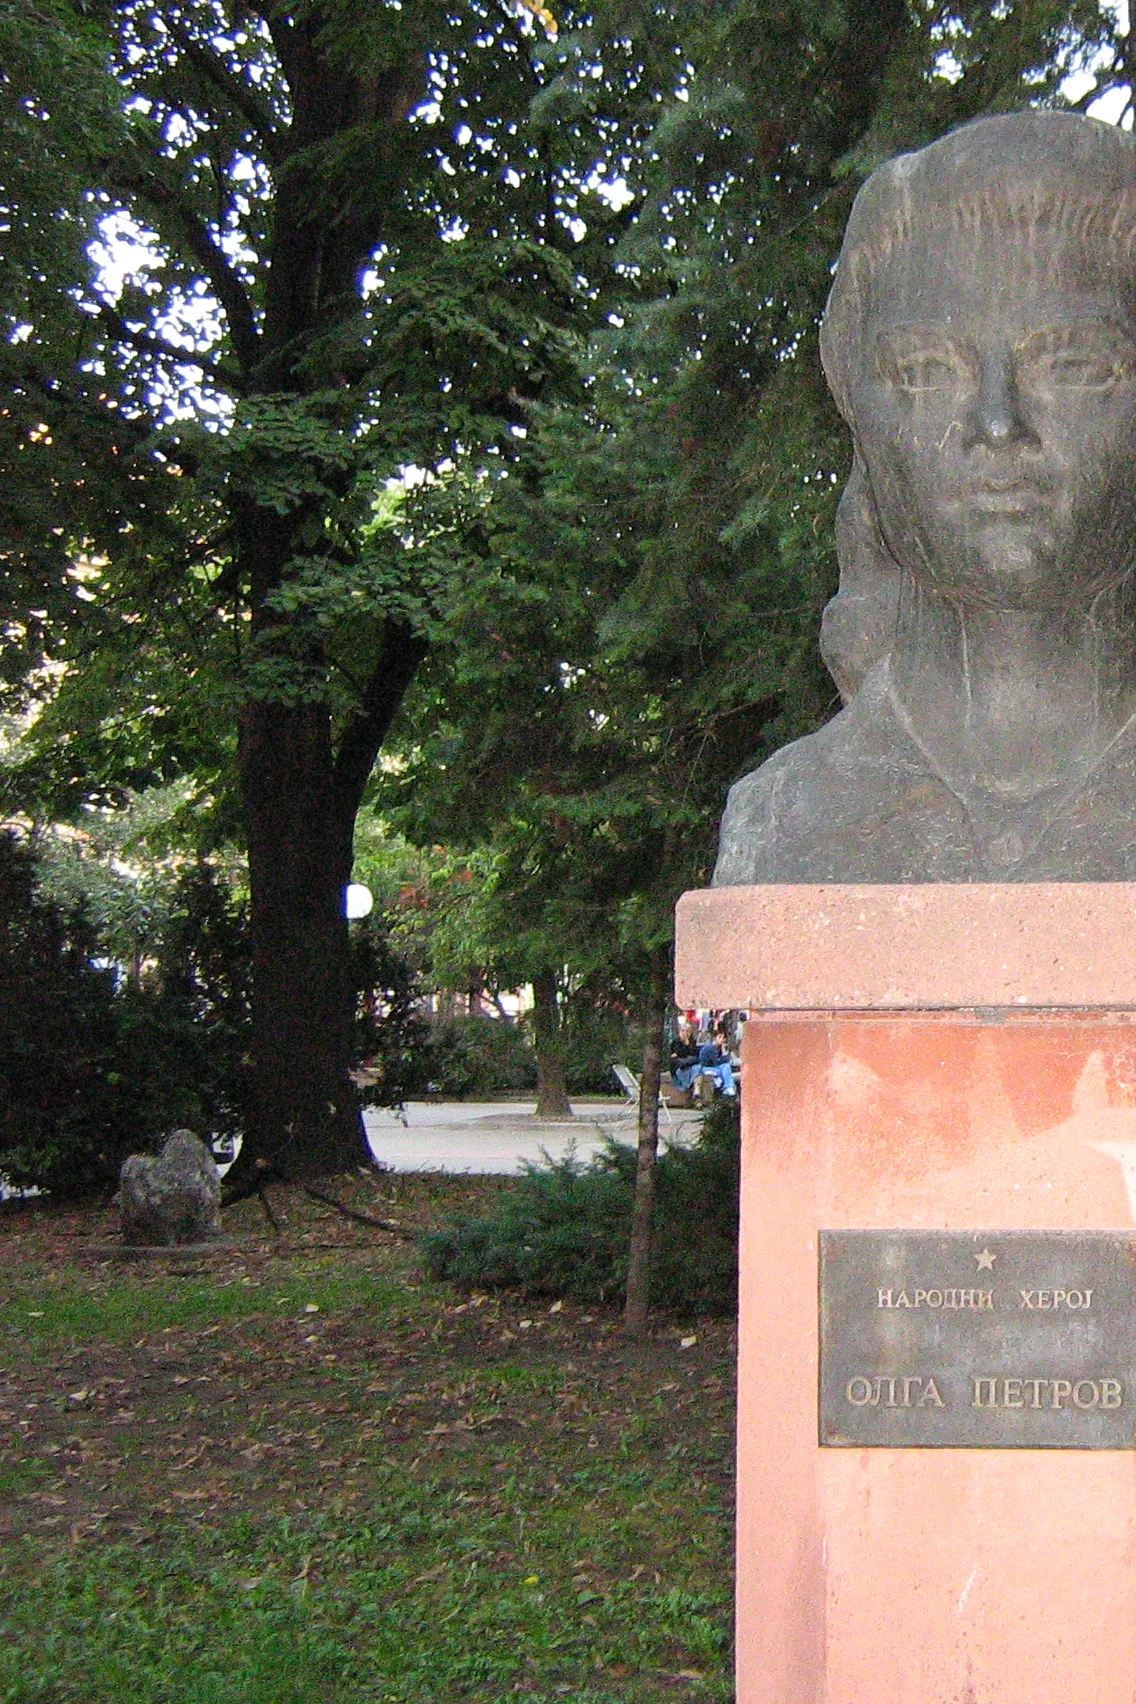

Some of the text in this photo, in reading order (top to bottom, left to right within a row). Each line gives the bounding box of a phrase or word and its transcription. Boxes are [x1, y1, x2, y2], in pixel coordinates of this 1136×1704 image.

[877, 1288, 1094, 1310] НАРОДНИ ХЕРОЈ
[845, 1375, 1123, 1410] ОЛГА ПЕТРОВ
